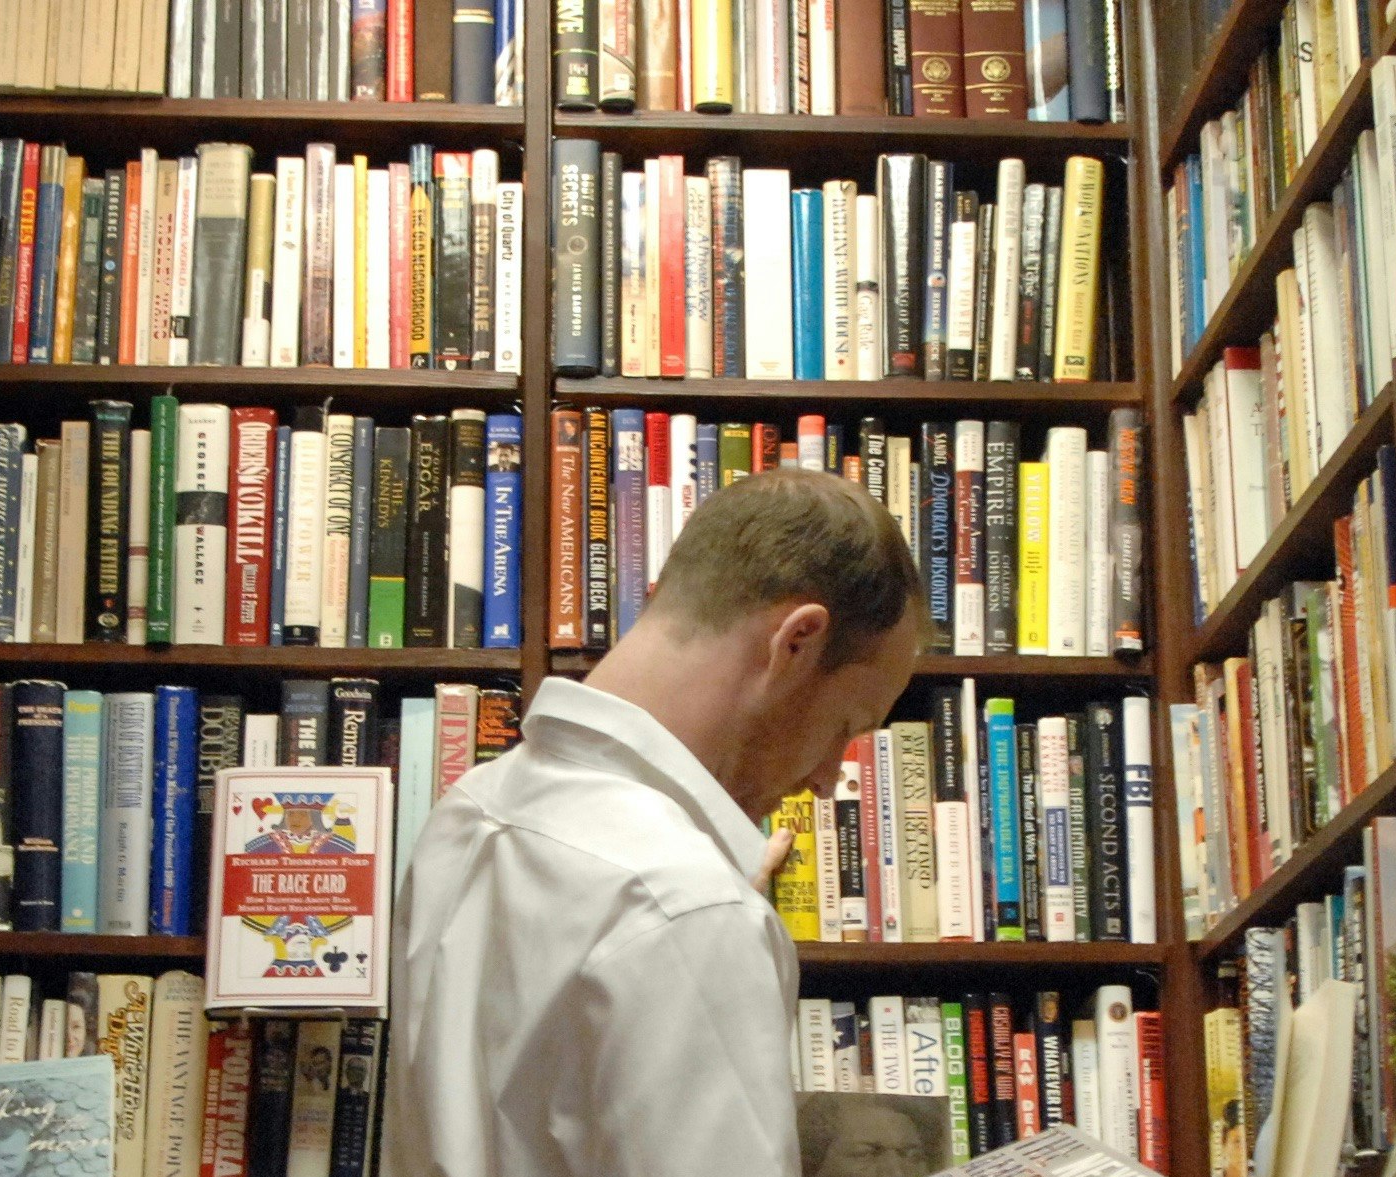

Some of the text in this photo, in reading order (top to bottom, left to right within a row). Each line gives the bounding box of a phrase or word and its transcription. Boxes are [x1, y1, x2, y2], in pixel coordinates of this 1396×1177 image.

[19, 188, 36, 245] CITIES
[107, 175, 121, 239] EMERGENCE
[581, 173, 595, 218] BODY OF
[411, 209, 425, 341] THE OLD NEIGHBORHOOD
[474, 215, 490, 331] END LINE
[561, 164, 583, 337] SECRETS JAMES BAMFORD
[99, 431, 121, 594] THE FOUNDING FATHER
[195, 432, 206, 585] GEORGE WALLACE
[378, 459, 392, 528] KENNEDYS
[393, 481, 404, 507] THE
[419, 442, 432, 513] EDGAR
[589, 413, 608, 611] AN INCONVENIENT BOOK GLENN BECK
[986, 441, 1005, 527] EMPIRE
[1004, 442, 1013, 527] THE SORROWS OF
[1027, 473, 1043, 544] YELLOW
[493, 487, 512, 597] IN THE ARENA
[560, 455, 575, 615] The New AMERICANS
[930, 433, 951, 621] SANDEL DEMOCRACY'S DISCONTENT
[969, 484, 982, 569] Captain America
[988, 550, 1001, 613] JOHNSON
[199, 706, 224, 781] DOUBT
[943, 698, 954, 726] Locked
[945, 740, 955, 753] the
[945, 755, 956, 788] Cabinet
[1125, 764, 1153, 808] FBI
[904, 816, 919, 880] REEVES
[995, 740, 1014, 884] THE IMPROBABLE ERA
[1025, 775, 1037, 861] The Mind at Work
[1099, 774, 1121, 910] SECOND ACTS
[232, 857, 369, 867] RICHARD THOMPSON FORD
[252, 873, 347, 894] THE RACE CARD
[918, 816, 931, 889] RICHARD
[7, 996, 24, 1051] Road to
[175, 1007, 193, 1044] THE
[810, 1008, 825, 1076] THE BEST OF
[881, 1021, 900, 1089] THE TWO
[169, 1050, 191, 1128] VANTAGE
[912, 1031, 939, 1095] Afte
[945, 1017, 968, 1156] BLOG RULES
[1018, 1049, 1036, 1138] RAW DEA
[1043, 1036, 1062, 1118] WHATEVER IT
[201, 1069, 222, 1164] RONNIE DUGGER
